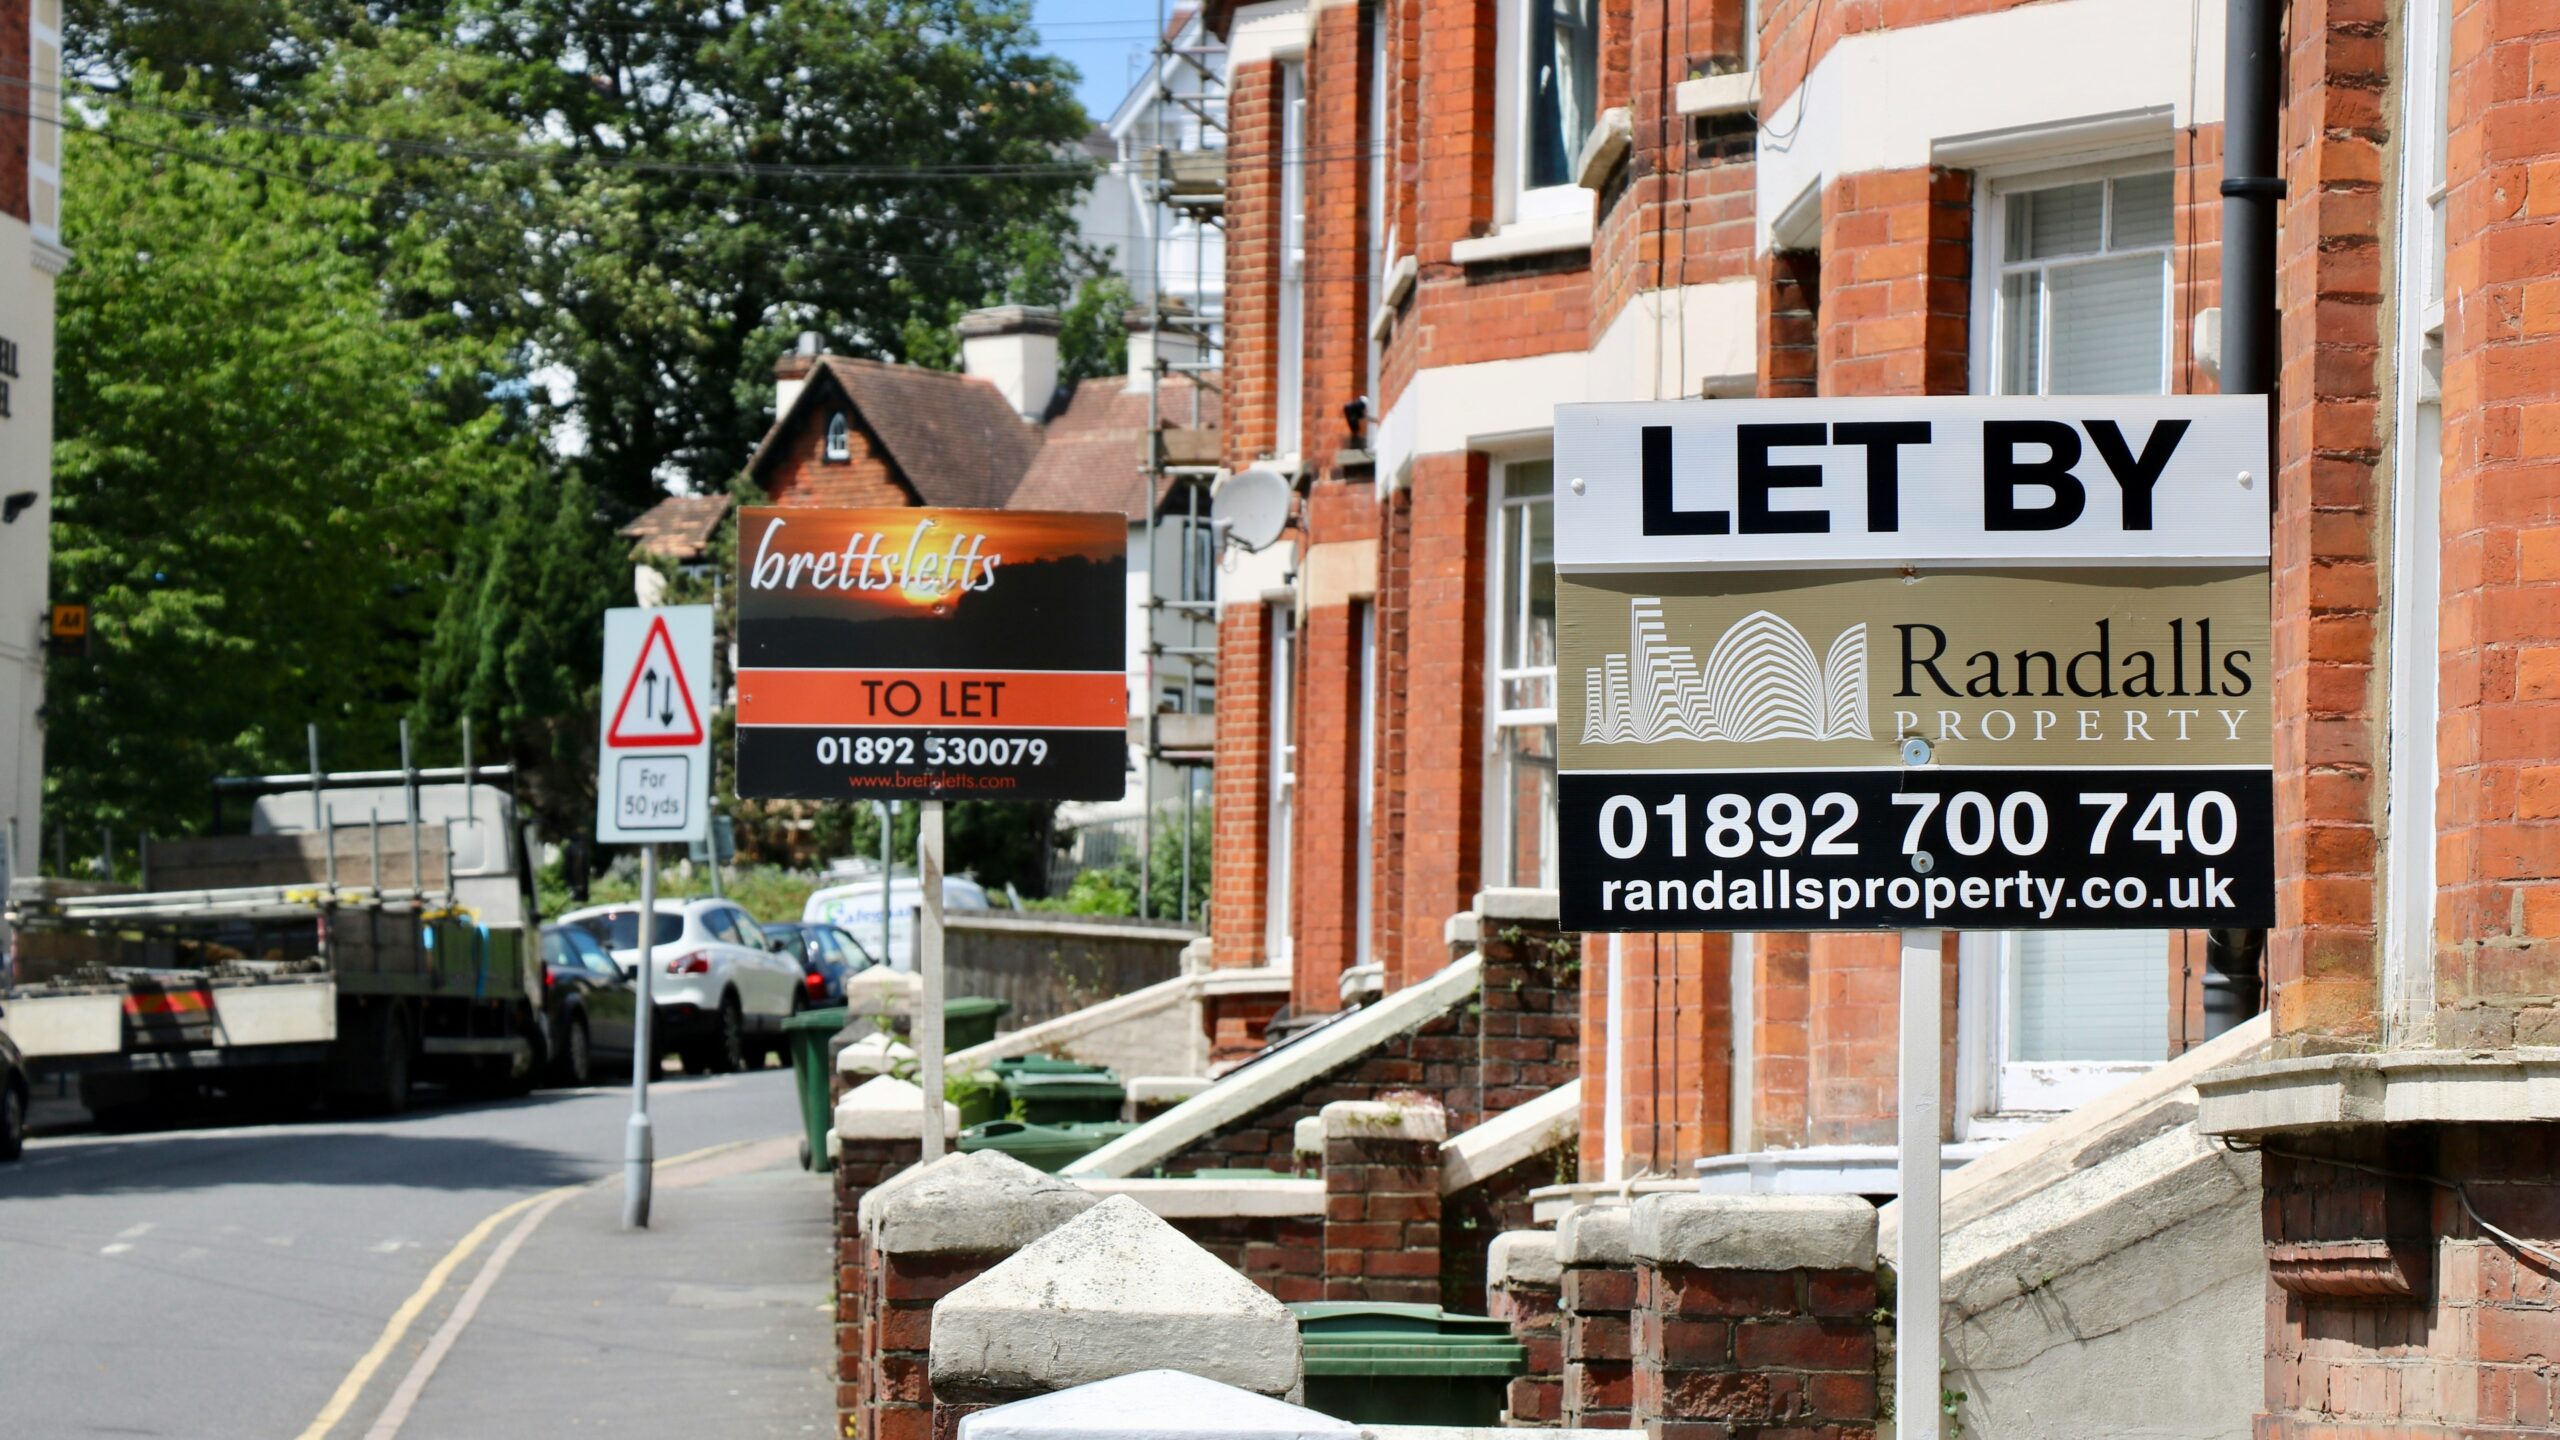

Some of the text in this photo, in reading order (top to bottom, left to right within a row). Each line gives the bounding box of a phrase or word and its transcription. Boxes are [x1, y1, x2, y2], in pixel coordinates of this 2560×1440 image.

[1641, 419, 2192, 536] LET BY
[750, 517, 1001, 592] brettsletts
[1892, 617, 2252, 699] Randalls
[860, 679, 1006, 718] TO LET
[1893, 709, 2249, 741] PROPERTY
[816, 736, 1049, 766] 01892 530079
[639, 767, 667, 788] For
[849, 770, 1017, 789] www.brettletts.com
[625, 794, 680, 819] 50 yds
[1598, 790, 2238, 860] 01892 700 740
[1601, 867, 2236, 921] randallsproperty.co.uk
